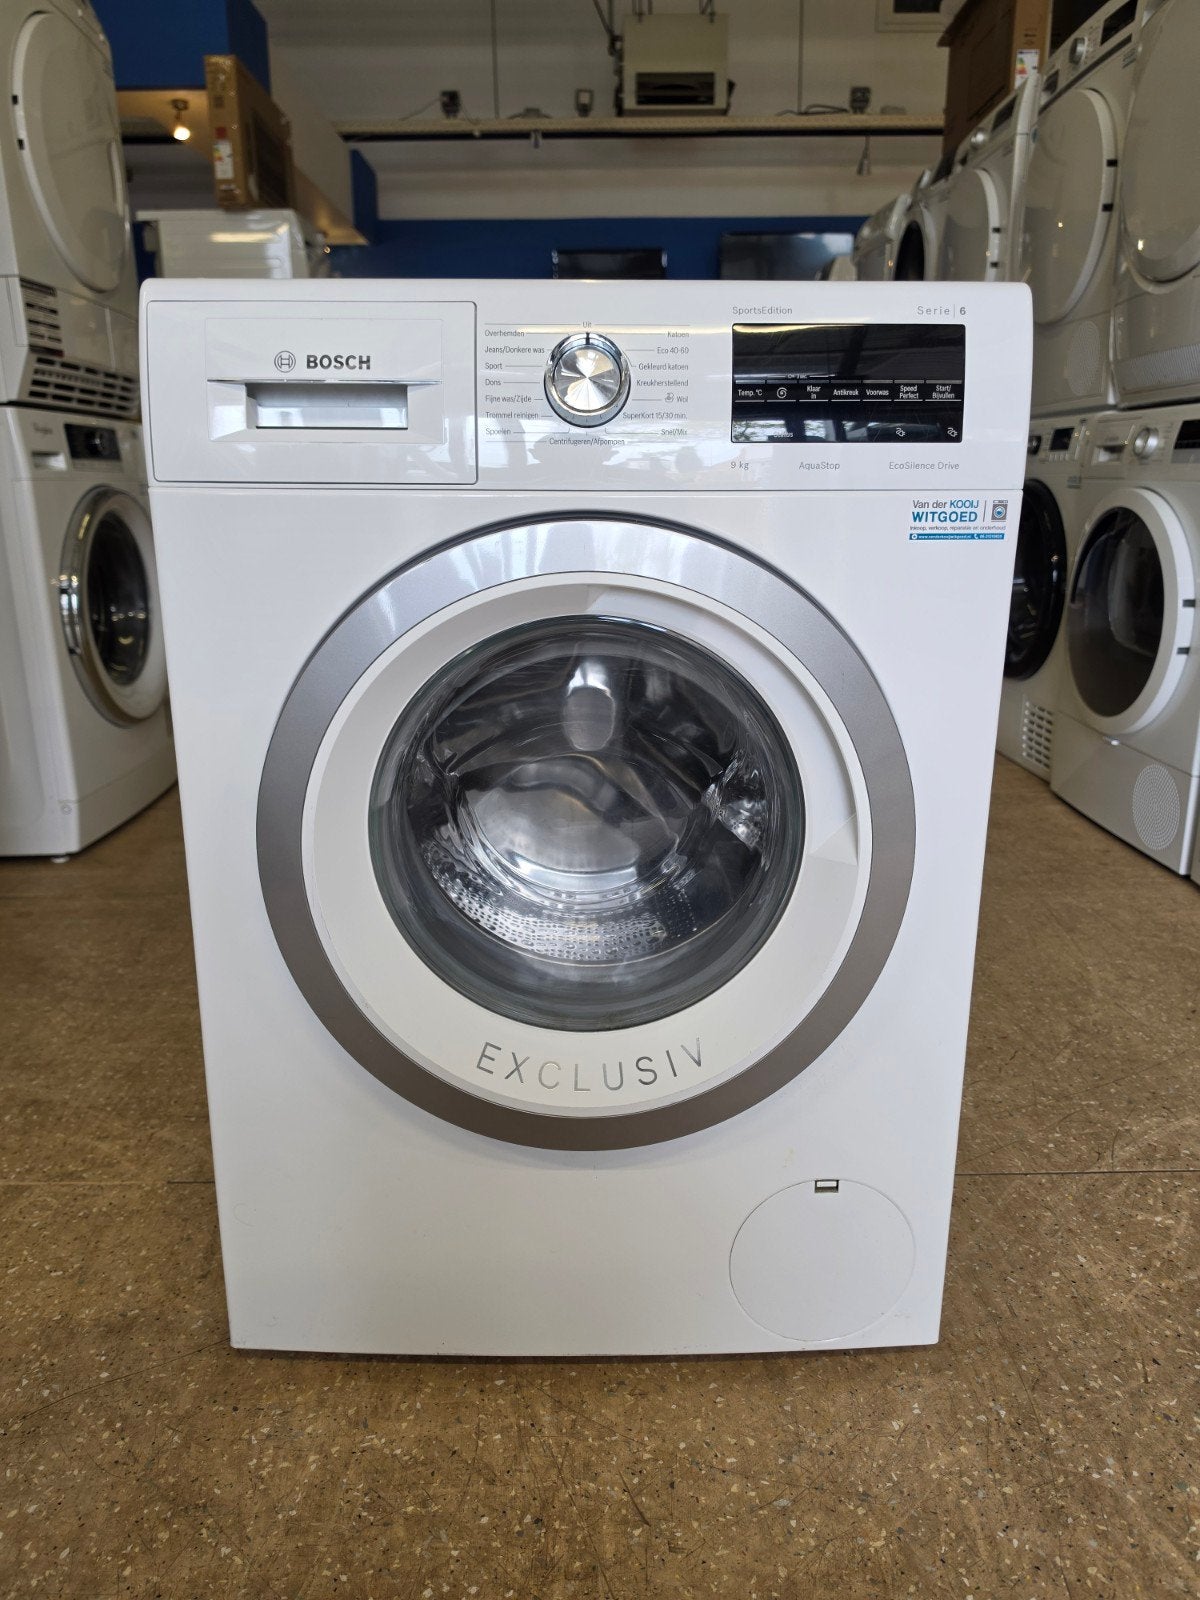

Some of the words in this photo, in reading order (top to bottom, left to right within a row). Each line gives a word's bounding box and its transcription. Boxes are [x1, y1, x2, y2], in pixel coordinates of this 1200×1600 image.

[732, 306, 793, 315] SportsEdition
[917, 306, 950, 315] Serie
[959, 306, 966, 315] 6
[484, 329, 525, 337] Overhemden
[484, 346, 532, 354] Jeans/Donkere
[306, 354, 371, 370] BOSCH
[485, 362, 503, 370] Sport
[485, 378, 502, 386] Dons
[738, 389, 754, 397] Temp.
[900, 385, 917, 393] Speed
[485, 395, 501, 403] Fijne
[501, 395, 532, 403] was/Zijde
[932, 392, 955, 400] Bijvullen
[513, 412, 539, 420] reinigen
[622, 412, 654, 420] SuperKort
[486, 428, 511, 436] Spoelen
[661, 428, 688, 436] Snel/Mix
[549, 438, 625, 446] Centrifugeren/Afpompen
[731, 461, 736, 469] 9
[738, 461, 749, 470] kg
[799, 461, 840, 470] AquaStop
[889, 461, 935, 470] EcoSilence
[937, 461, 960, 470] Drive
[912, 500, 929, 509] Van
[932, 500, 947, 509] der
[949, 500, 979, 509] KOOIJ
[912, 511, 978, 522] WITGOED
[475, 1037, 702, 1092] EXCLUSIV
